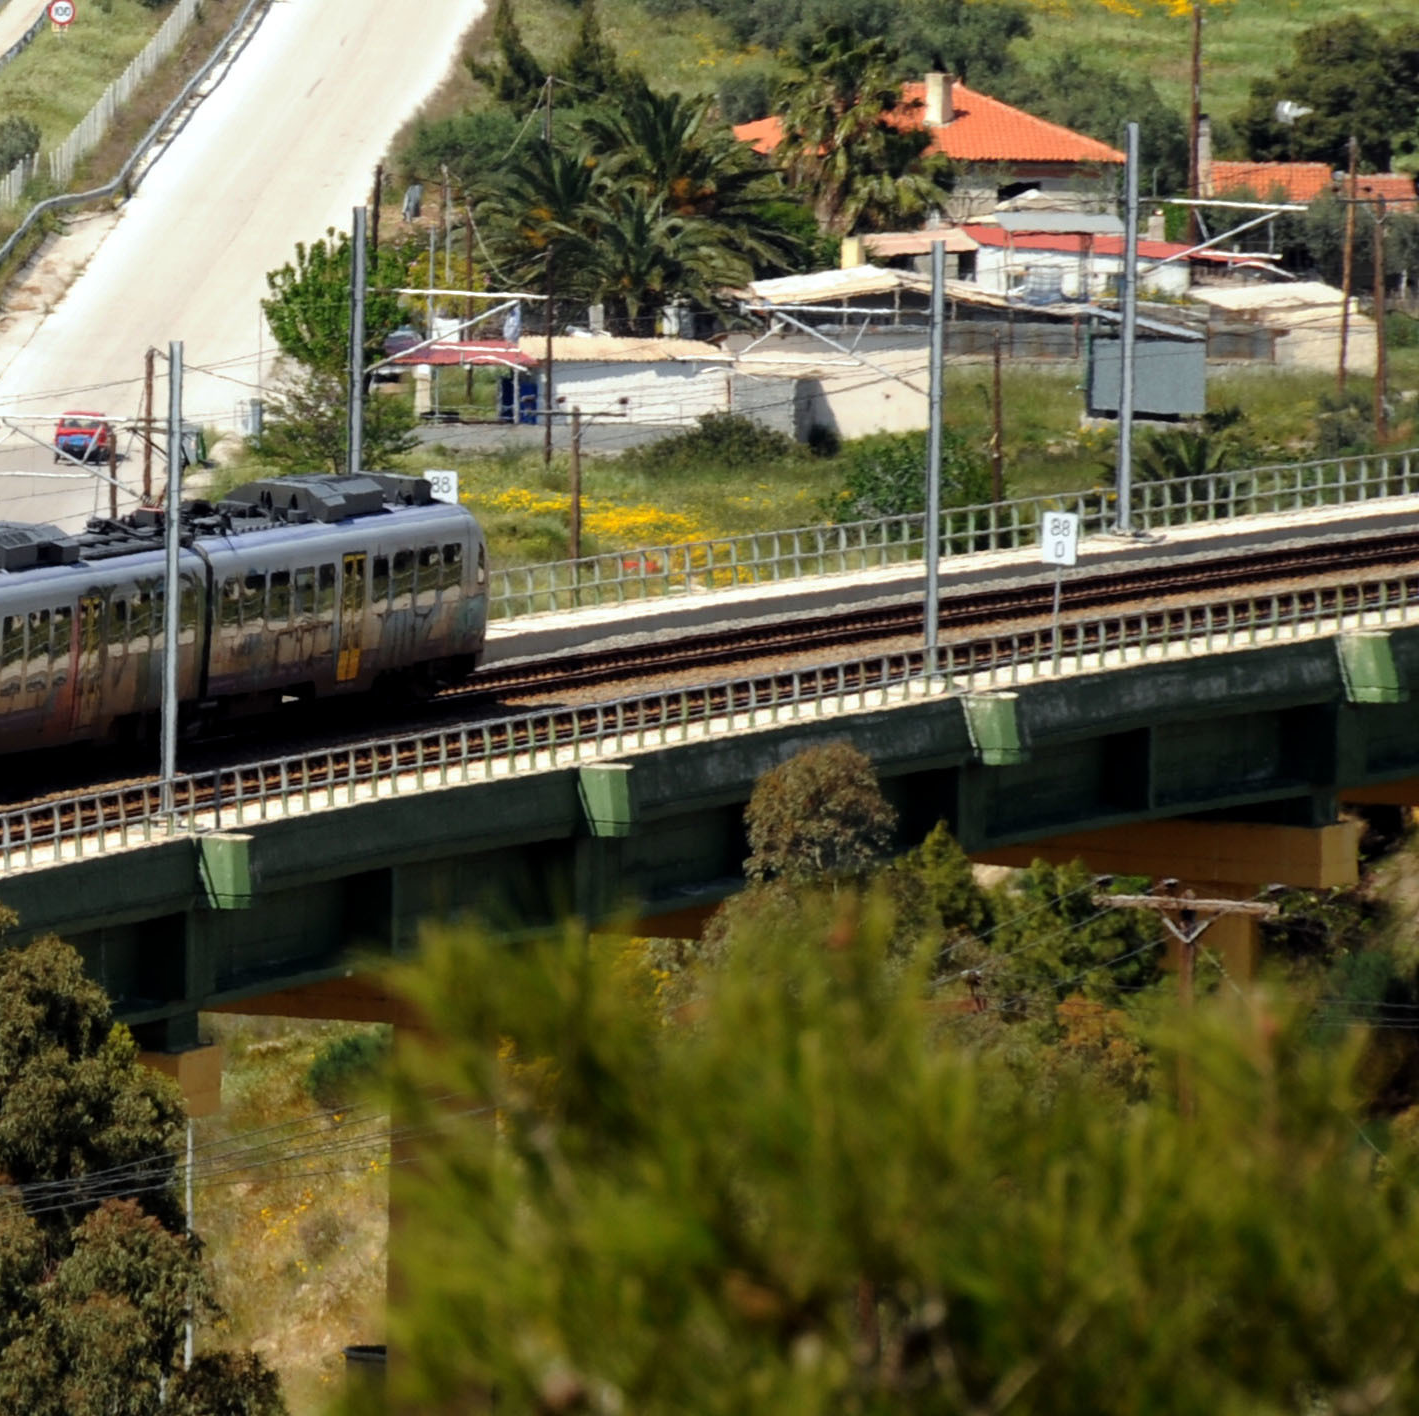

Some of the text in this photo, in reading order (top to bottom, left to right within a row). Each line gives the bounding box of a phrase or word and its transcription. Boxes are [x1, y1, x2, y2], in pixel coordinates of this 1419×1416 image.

[54, 6, 71, 17] 100
[432, 476, 451, 494] 88
[1050, 517, 1071, 537] 88
[1054, 540, 1065, 559] 0
